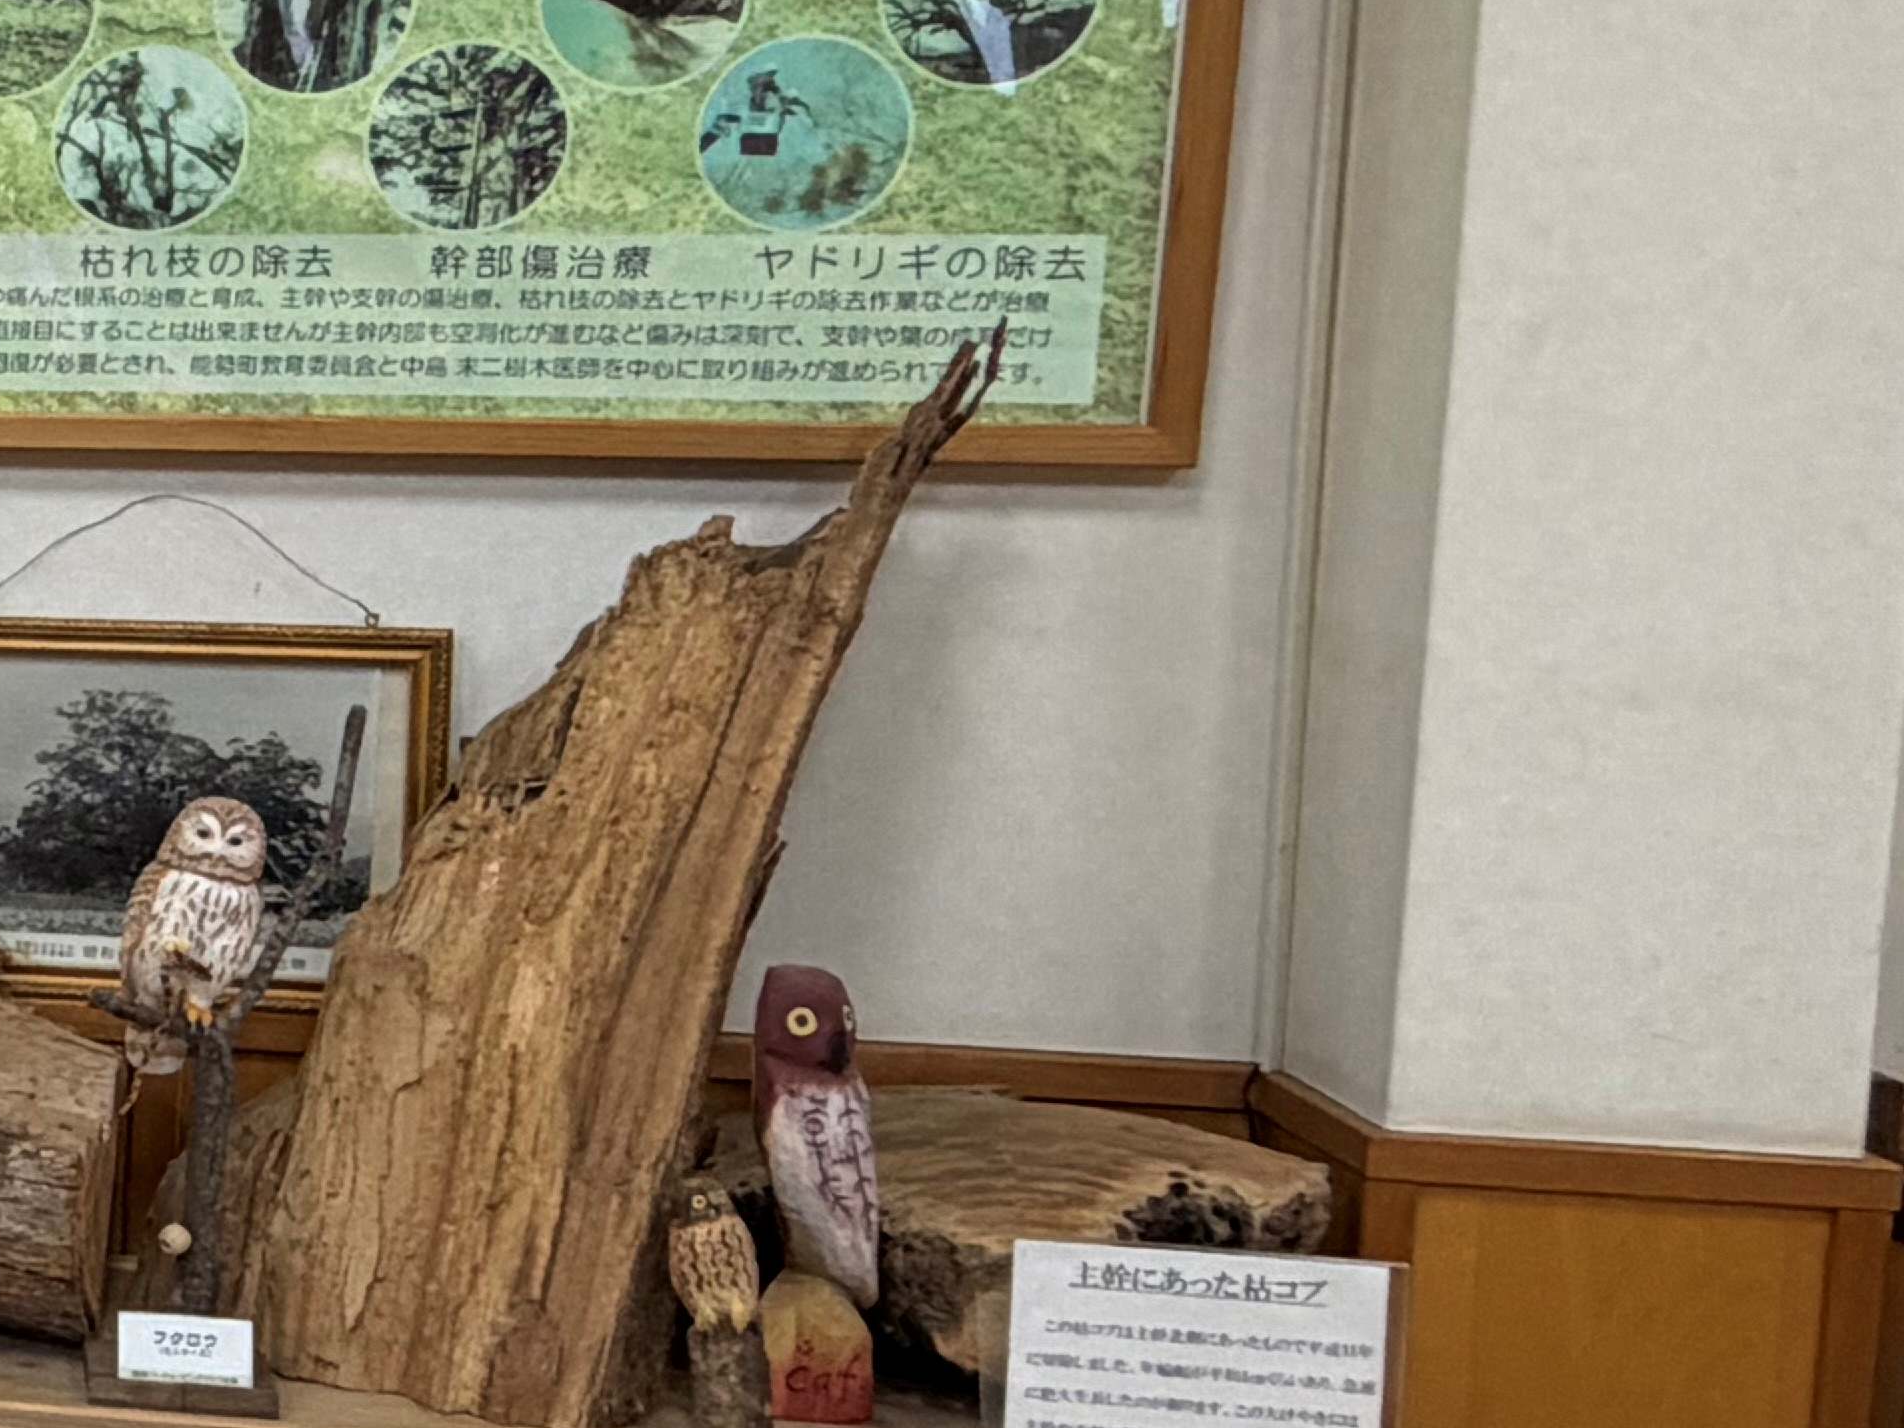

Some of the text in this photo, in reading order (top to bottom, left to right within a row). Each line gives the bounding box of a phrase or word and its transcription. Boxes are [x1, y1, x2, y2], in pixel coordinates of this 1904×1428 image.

[78, 244, 334, 279] 枯れ枝の除去
[430, 244, 653, 280] 幹部傷治療
[755, 244, 1087, 281] ヤドリギの除去
[1072, 1260, 1329, 1304] 主幹にあった枯コブ
